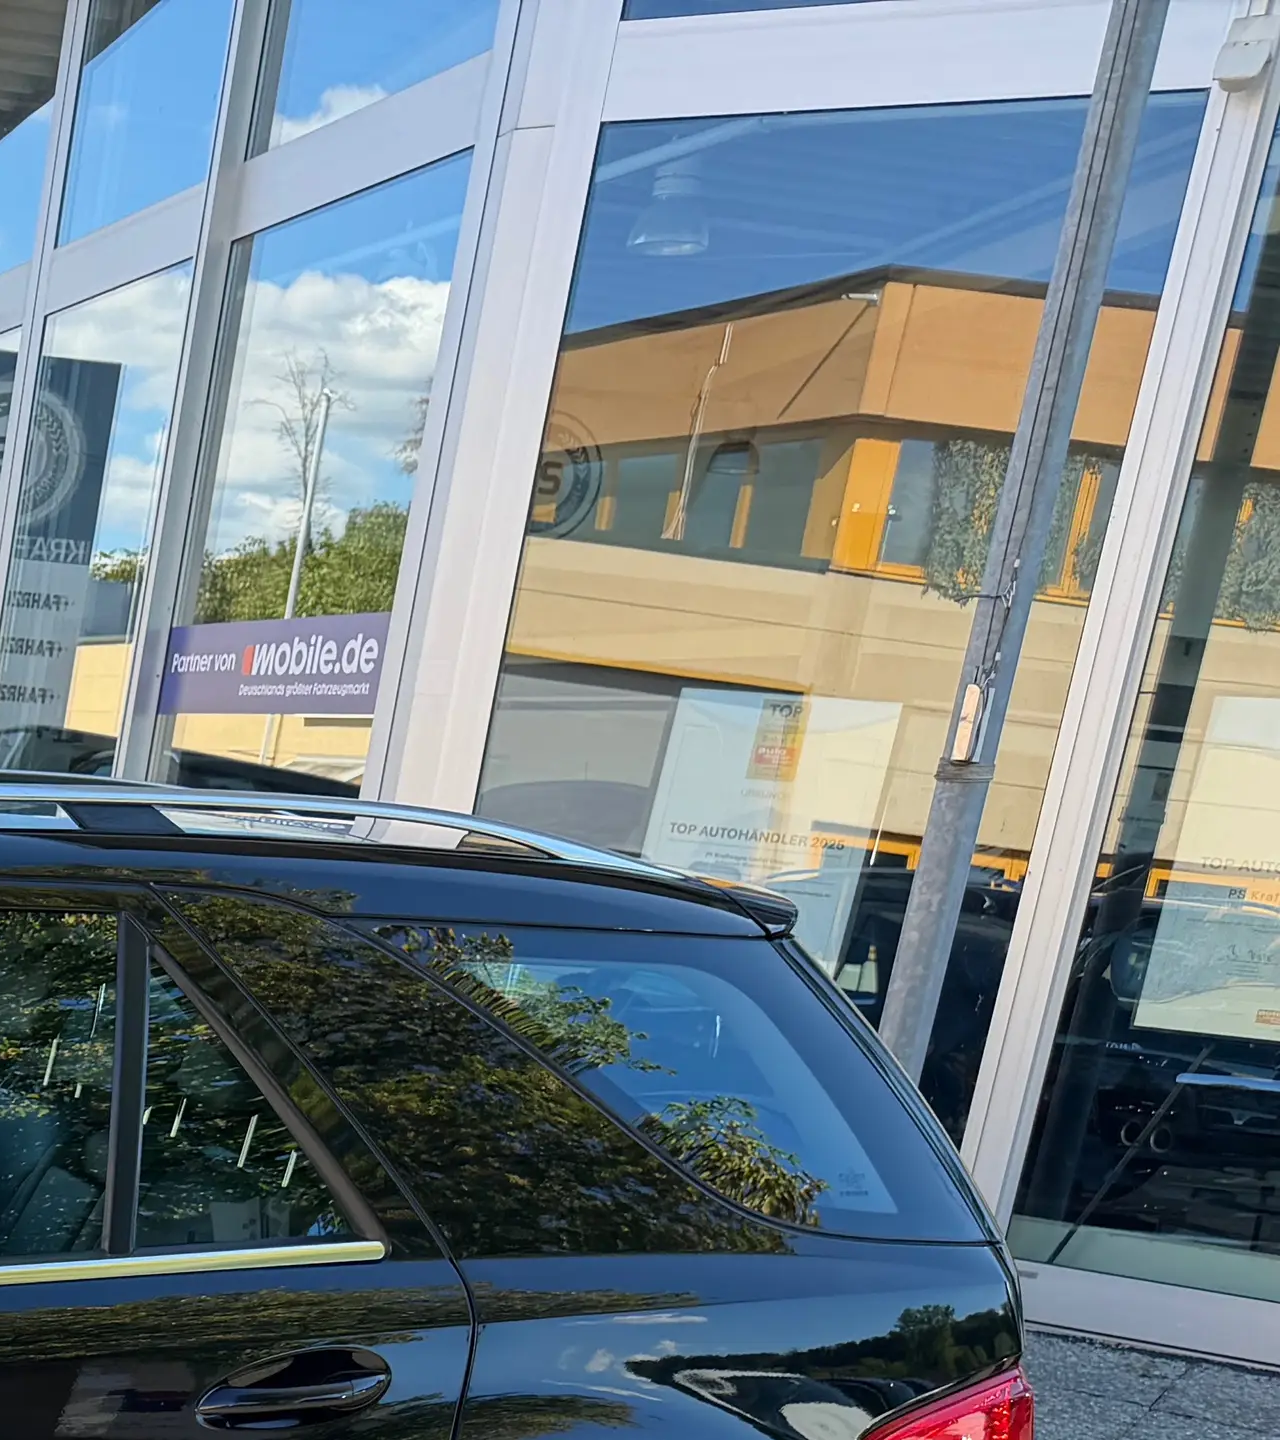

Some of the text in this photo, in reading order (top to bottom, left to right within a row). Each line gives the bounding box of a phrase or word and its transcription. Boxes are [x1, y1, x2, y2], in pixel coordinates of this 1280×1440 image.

[171, 633, 379, 676] Partner von mobile.de
[769, 703, 804, 719] TOP
[669, 821, 845, 851] TOP AUTOHÄNDLER 2025
[1200, 856, 1235, 871] TOP
[1227, 888, 1248, 900] PS
